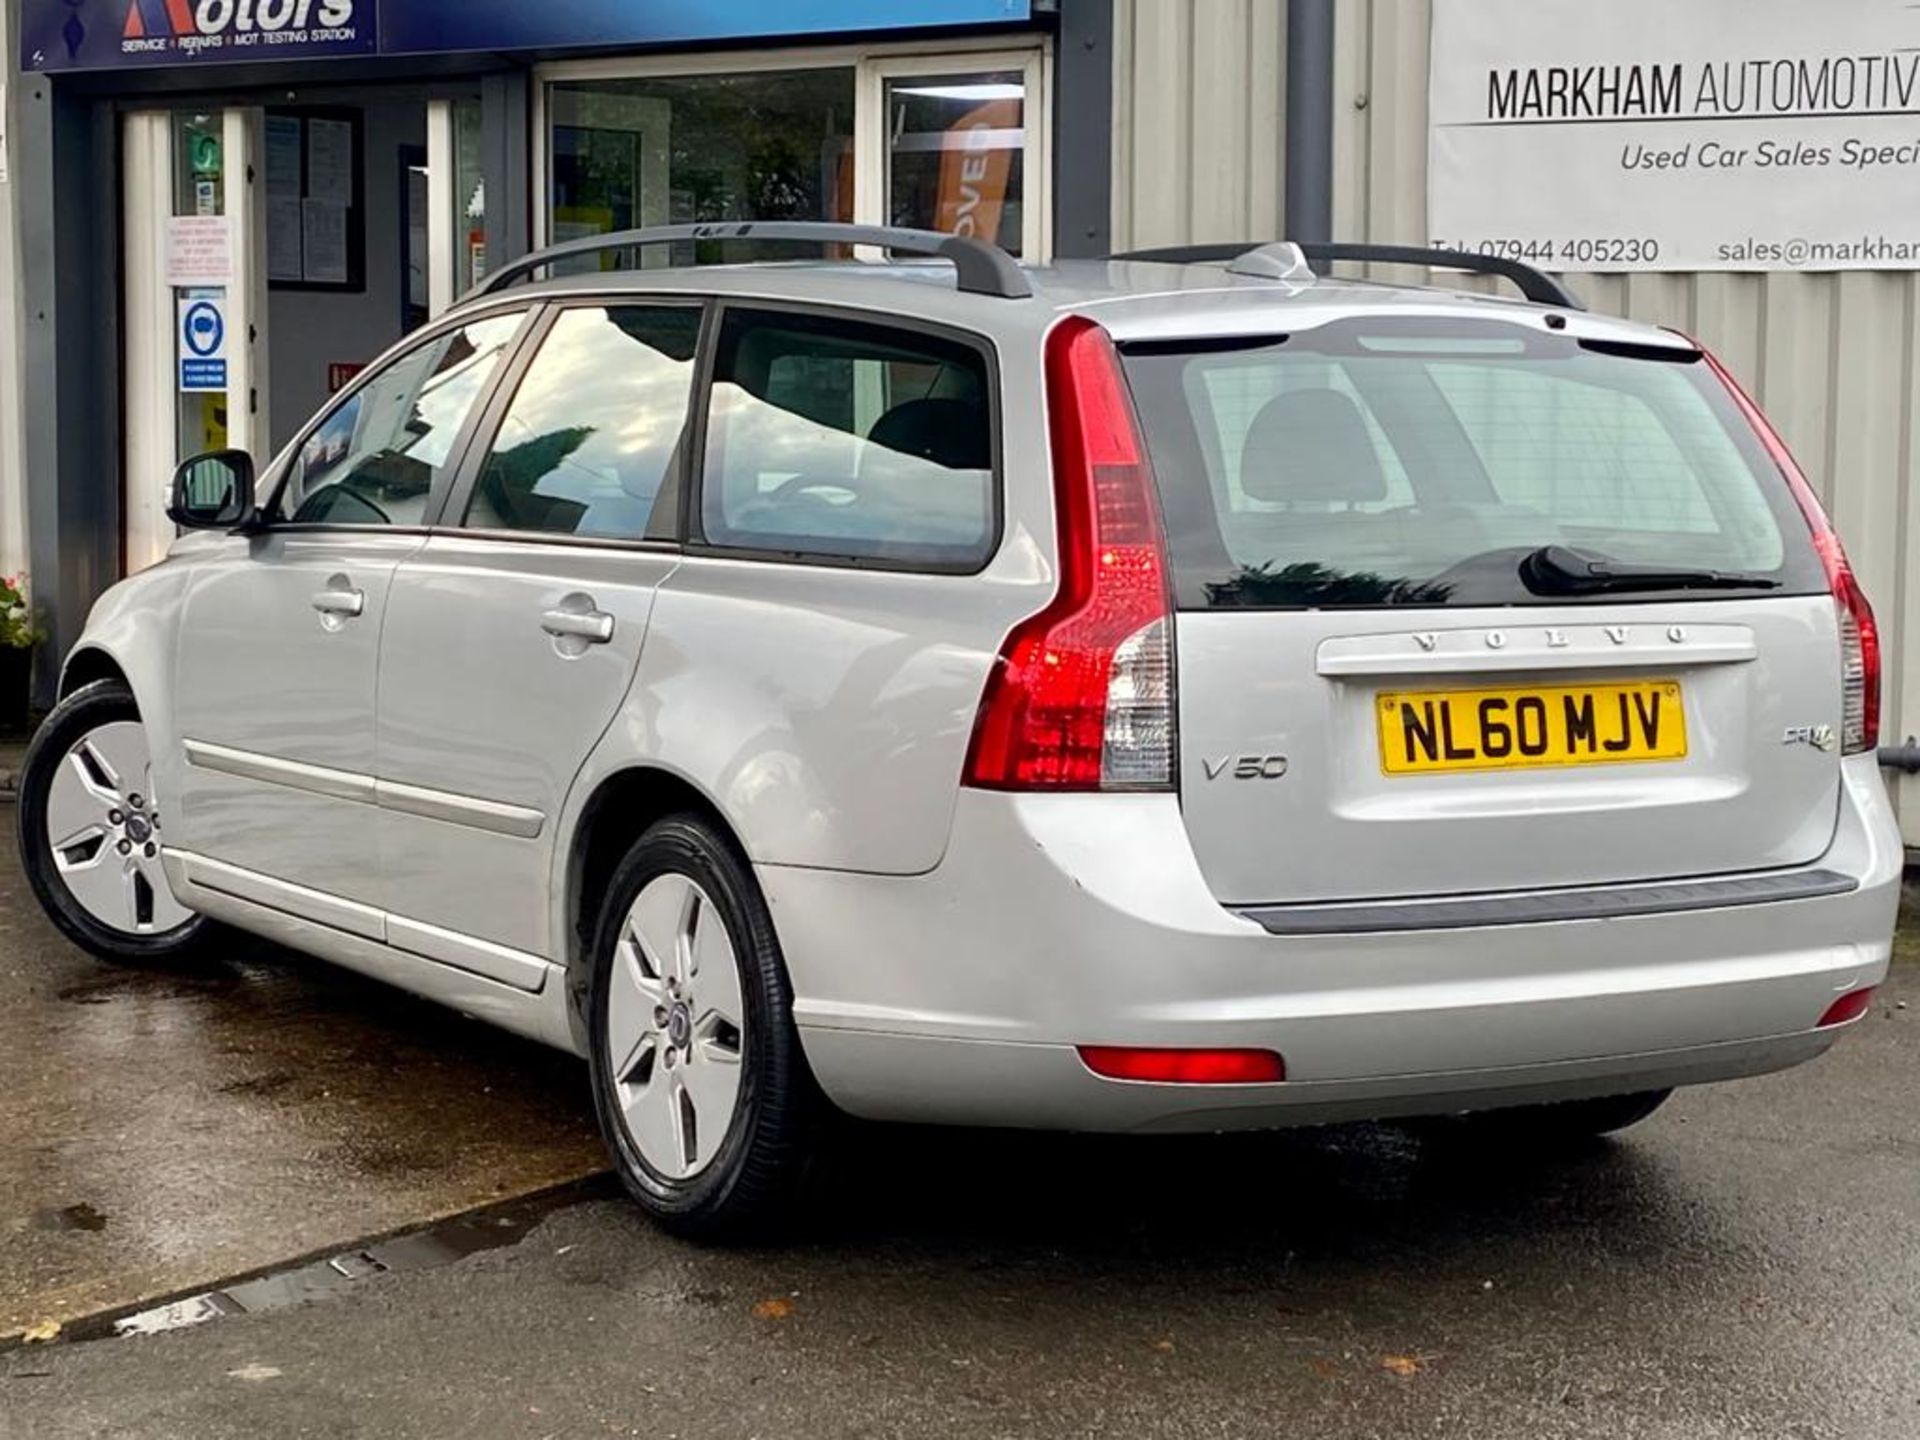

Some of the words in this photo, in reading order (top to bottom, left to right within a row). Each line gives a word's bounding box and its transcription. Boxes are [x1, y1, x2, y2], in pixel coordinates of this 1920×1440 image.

[121, 39, 167, 53] SERVICE
[178, 35, 223, 49] REPAIRS
[234, 32, 259, 46] MOT
[262, 29, 308, 44] TESTING
[311, 27, 355, 42] STATION
[1487, 63, 1683, 119] MARKHAM
[1620, 144, 1691, 170] Used
[1698, 142, 1748, 168] Car
[1755, 140, 1831, 167] Sales
[1478, 239, 1554, 262] 07944
[1560, 238, 1659, 263] 405230
[1411, 624, 1694, 652] VOLVO
[1400, 696, 1548, 763] NL60
[1563, 691, 1661, 755] MJV
